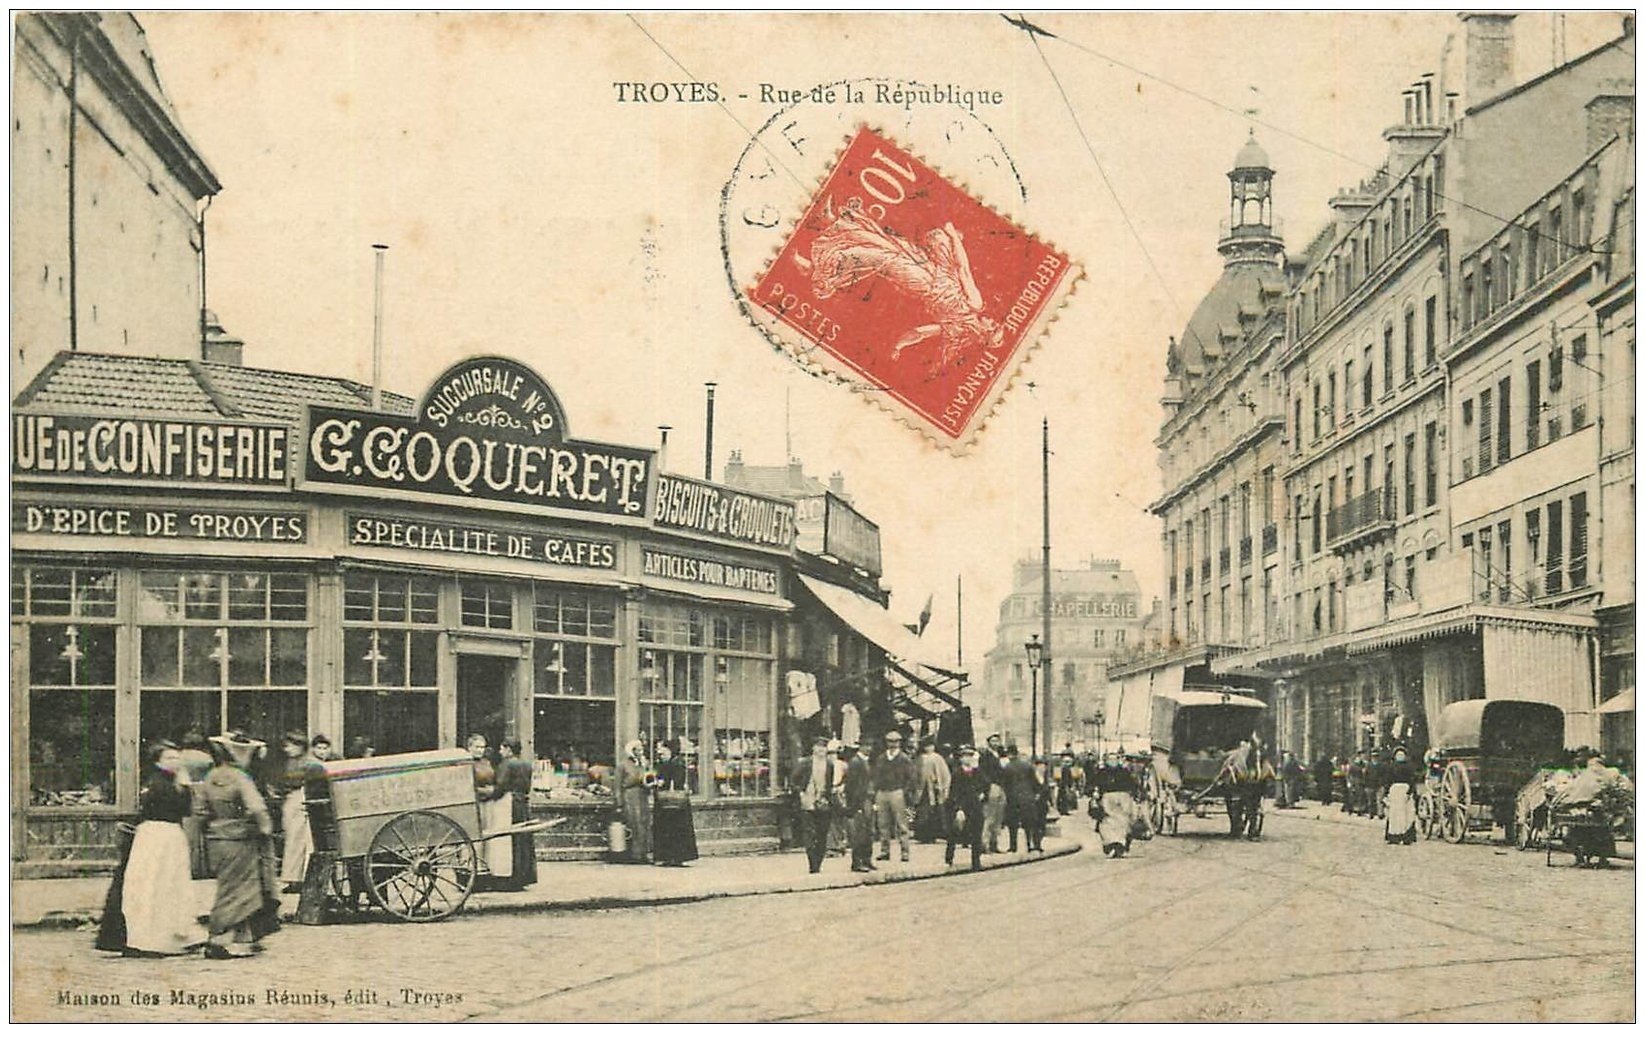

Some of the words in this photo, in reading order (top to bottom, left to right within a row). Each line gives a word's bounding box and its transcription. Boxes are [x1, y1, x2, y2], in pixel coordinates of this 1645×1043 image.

[769, 282, 841, 341] POSTES
[426, 367, 525, 428] SUCCURSALE
[531, 412, 554, 435] 2
[16, 415, 55, 470] UE
[57, 429, 86, 471] DE
[87, 420, 285, 480] CONFISERIE
[310, 418, 362, 477] G.
[361, 424, 646, 514] COQUERET
[145, 511, 179, 537] DE
[189, 513, 303, 541] TROYES
[653, 477, 719, 532] BISCUITS
[729, 494, 794, 545] CROQUETS
[507, 534, 534, 559] DE
[644, 551, 698, 581] ARTICLES
